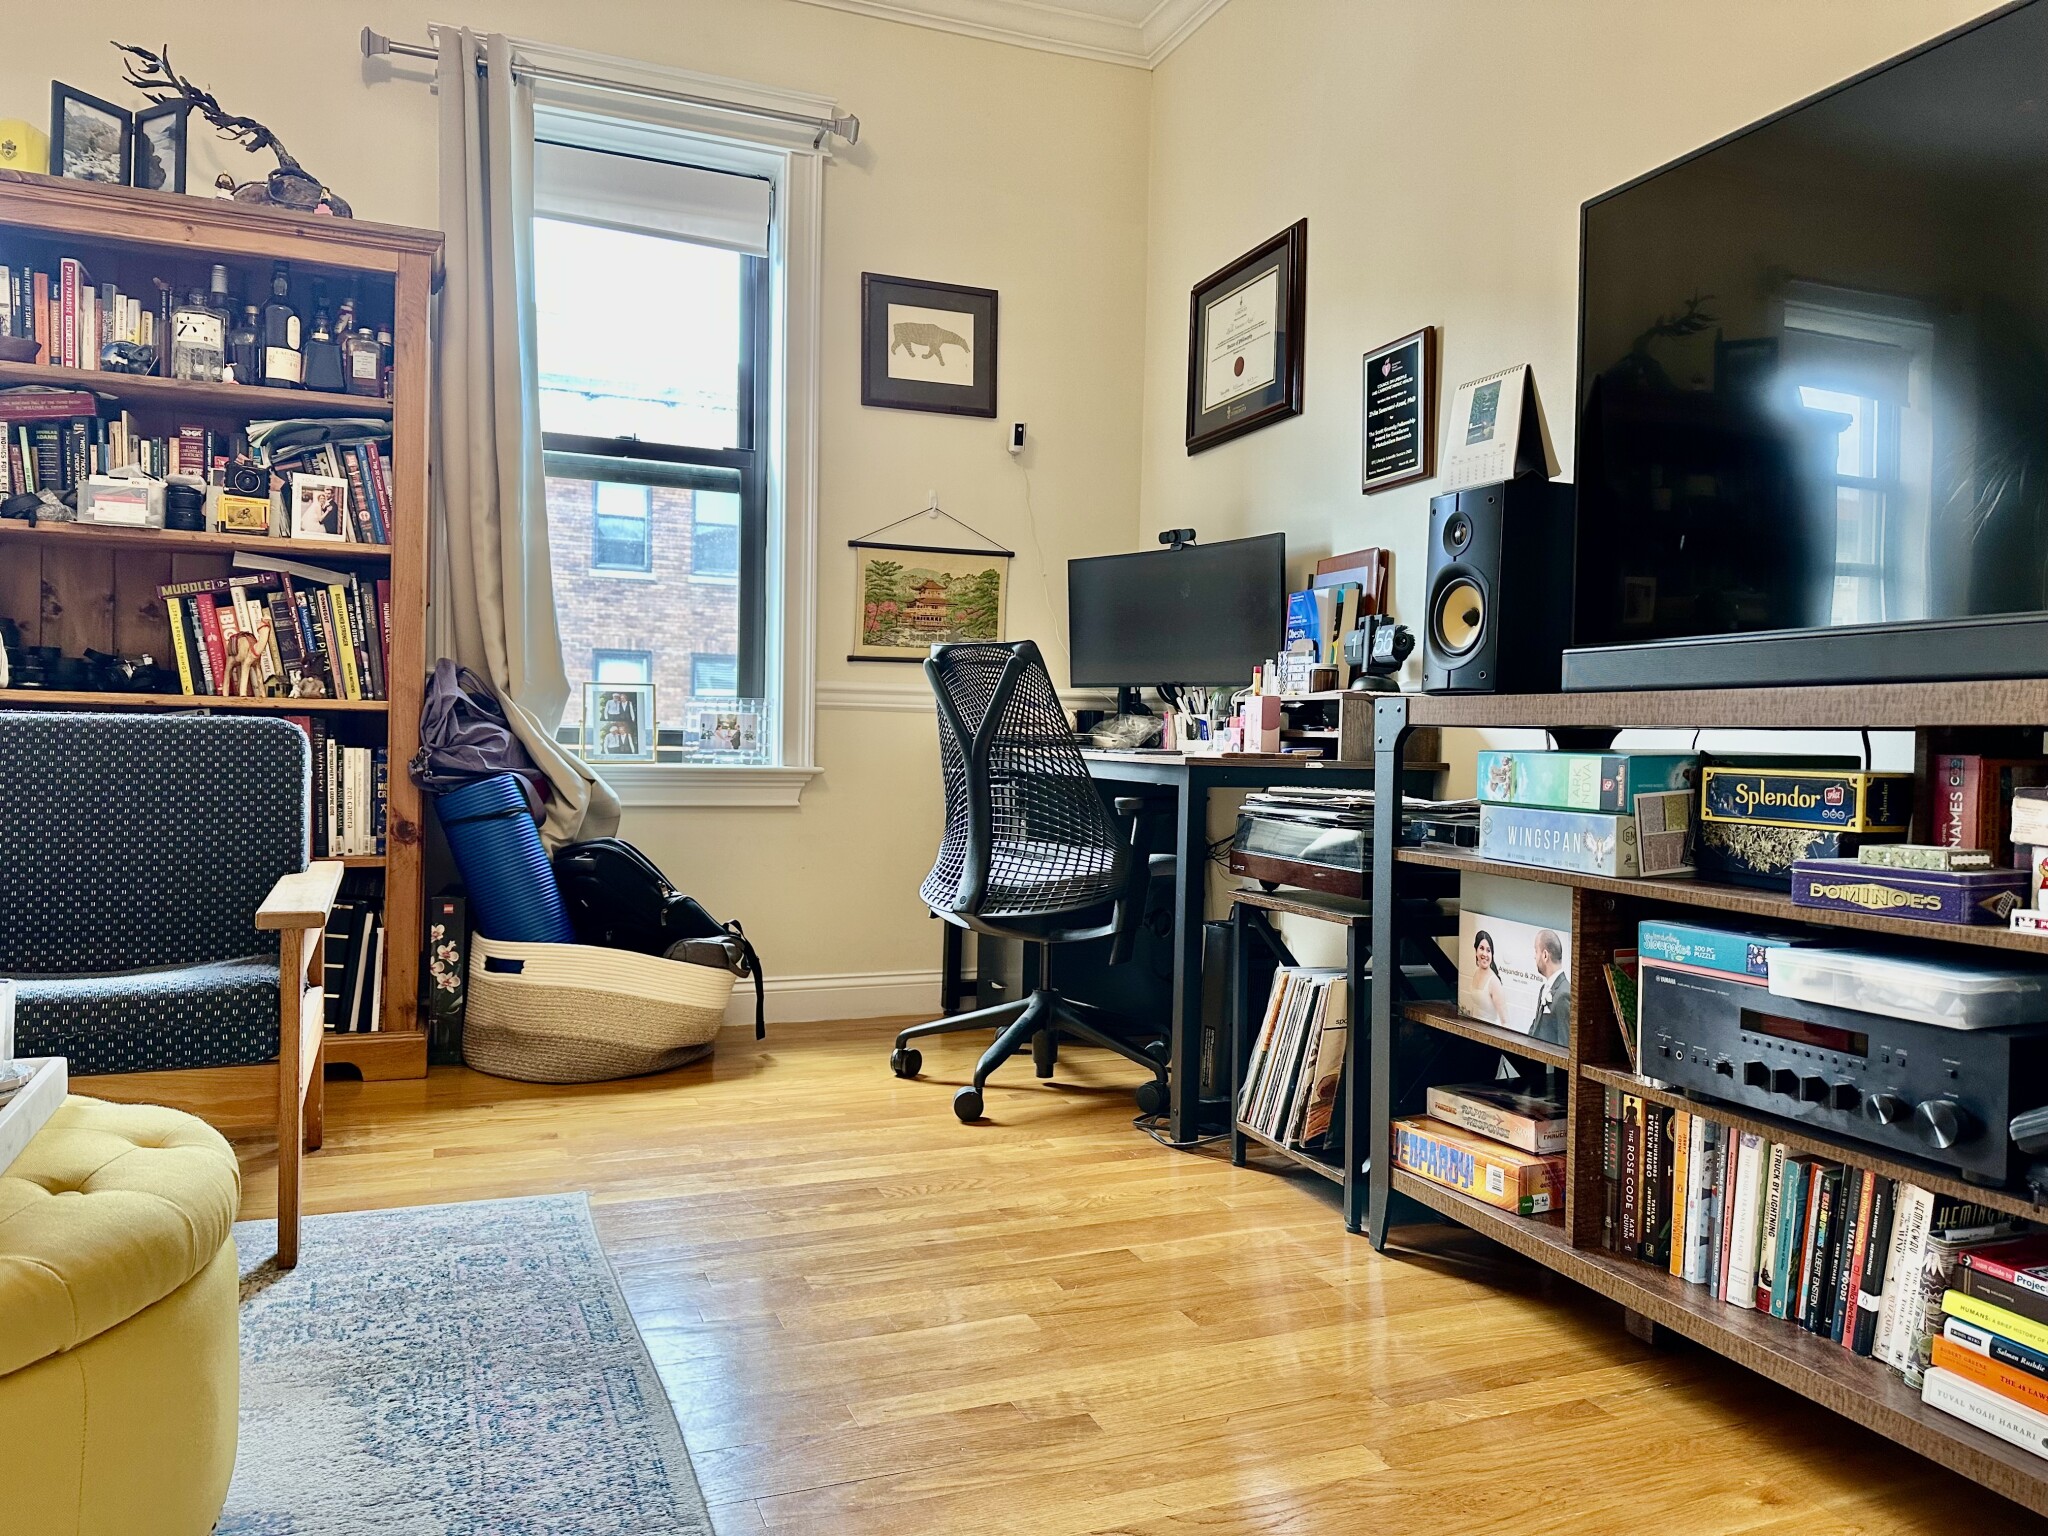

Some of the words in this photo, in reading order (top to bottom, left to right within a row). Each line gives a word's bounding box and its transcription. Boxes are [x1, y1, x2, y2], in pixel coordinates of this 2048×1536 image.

[162, 581, 211, 596] MURDLE
[206, 601, 215, 628] PHANTOM
[320, 594, 329, 623] VONNEGUT
[383, 603, 391, 627] HUMMUS
[304, 629, 313, 649] Freeman
[313, 623, 323, 637] MY
[340, 625, 348, 646] STRONGER
[1352, 634, 1357, 657] 1
[1375, 629, 1394, 652] 56
[316, 750, 326, 796] Whisky
[1572, 768, 1581, 798] ARK
[1581, 762, 1592, 804] NOVA
[1735, 779, 1821, 815] Splendor
[1827, 792, 1841, 800] SPACE
[1881, 783, 1889, 822] Splendor
[1508, 825, 1582, 854] WINGSPAN
[1810, 883, 1942, 911] DOMINOES
[1694, 952, 1716, 960] PUZZLE
[1706, 946, 1714, 954] PC
[1499, 966, 1523, 978] Alejandro
[1660, 977, 1676, 985] YAMAHA
[1462, 1104, 1488, 1120] RAPID
[1466, 1117, 1510, 1139] RESPONSE
[1392, 1128, 1475, 1188] JEOPARDY!
[1608, 1133, 1617, 1168] TICKET
[1627, 1144, 1635, 1175] ROSE
[1774, 1149, 1782, 1179] STRUCK
[1625, 1177, 1634, 1210] CODE
[1772, 1181, 1779, 1192] BY
[1863, 1173, 1871, 1191] math
[1821, 1192, 1829, 1209] IDEAS
[1859, 1193, 1868, 1222] without
[1768, 1194, 1778, 1237] LIGHTNING
[1909, 1201, 1923, 1253] HEMINGWAY
[1855, 1223, 1864, 1255] numbers
[1896, 1230, 1904, 1253] WIND
[1814, 1249, 1822, 1275] ALBERT
[1976, 1261, 1987, 1270] HBR
[1988, 1265, 2005, 1277] Guide
[2006, 1270, 2012, 1280] to
[1811, 1277, 1819, 1307] EINSTEIN
[1840, 1271, 1849, 1301] WOODS
[1899, 1299, 1907, 1325] TOLLS
[1908, 1289, 1916, 1315] WHOM
[1845, 1301, 1855, 1333] beckman
[1960, 1305, 1990, 1320] HUMANS:
[1997, 1320, 2012, 1330] BRIEF
[2014, 1327, 2036, 1340] HISTORY
[1940, 1347, 1962, 1359] ROBERT
[1964, 1355, 1987, 1370] GREENE
[1996, 1347, 2018, 1361] Salman
[2020, 1356, 2046, 1372] Rushdie
[2000, 1375, 2016, 1387] THE
[2028, 1388, 2048, 1402] LAWS
[1937, 1390, 1965, 1408] YUVAL
[1969, 1404, 1995, 1421] NOAH
[1999, 1418, 2036, 1440] HARARI
